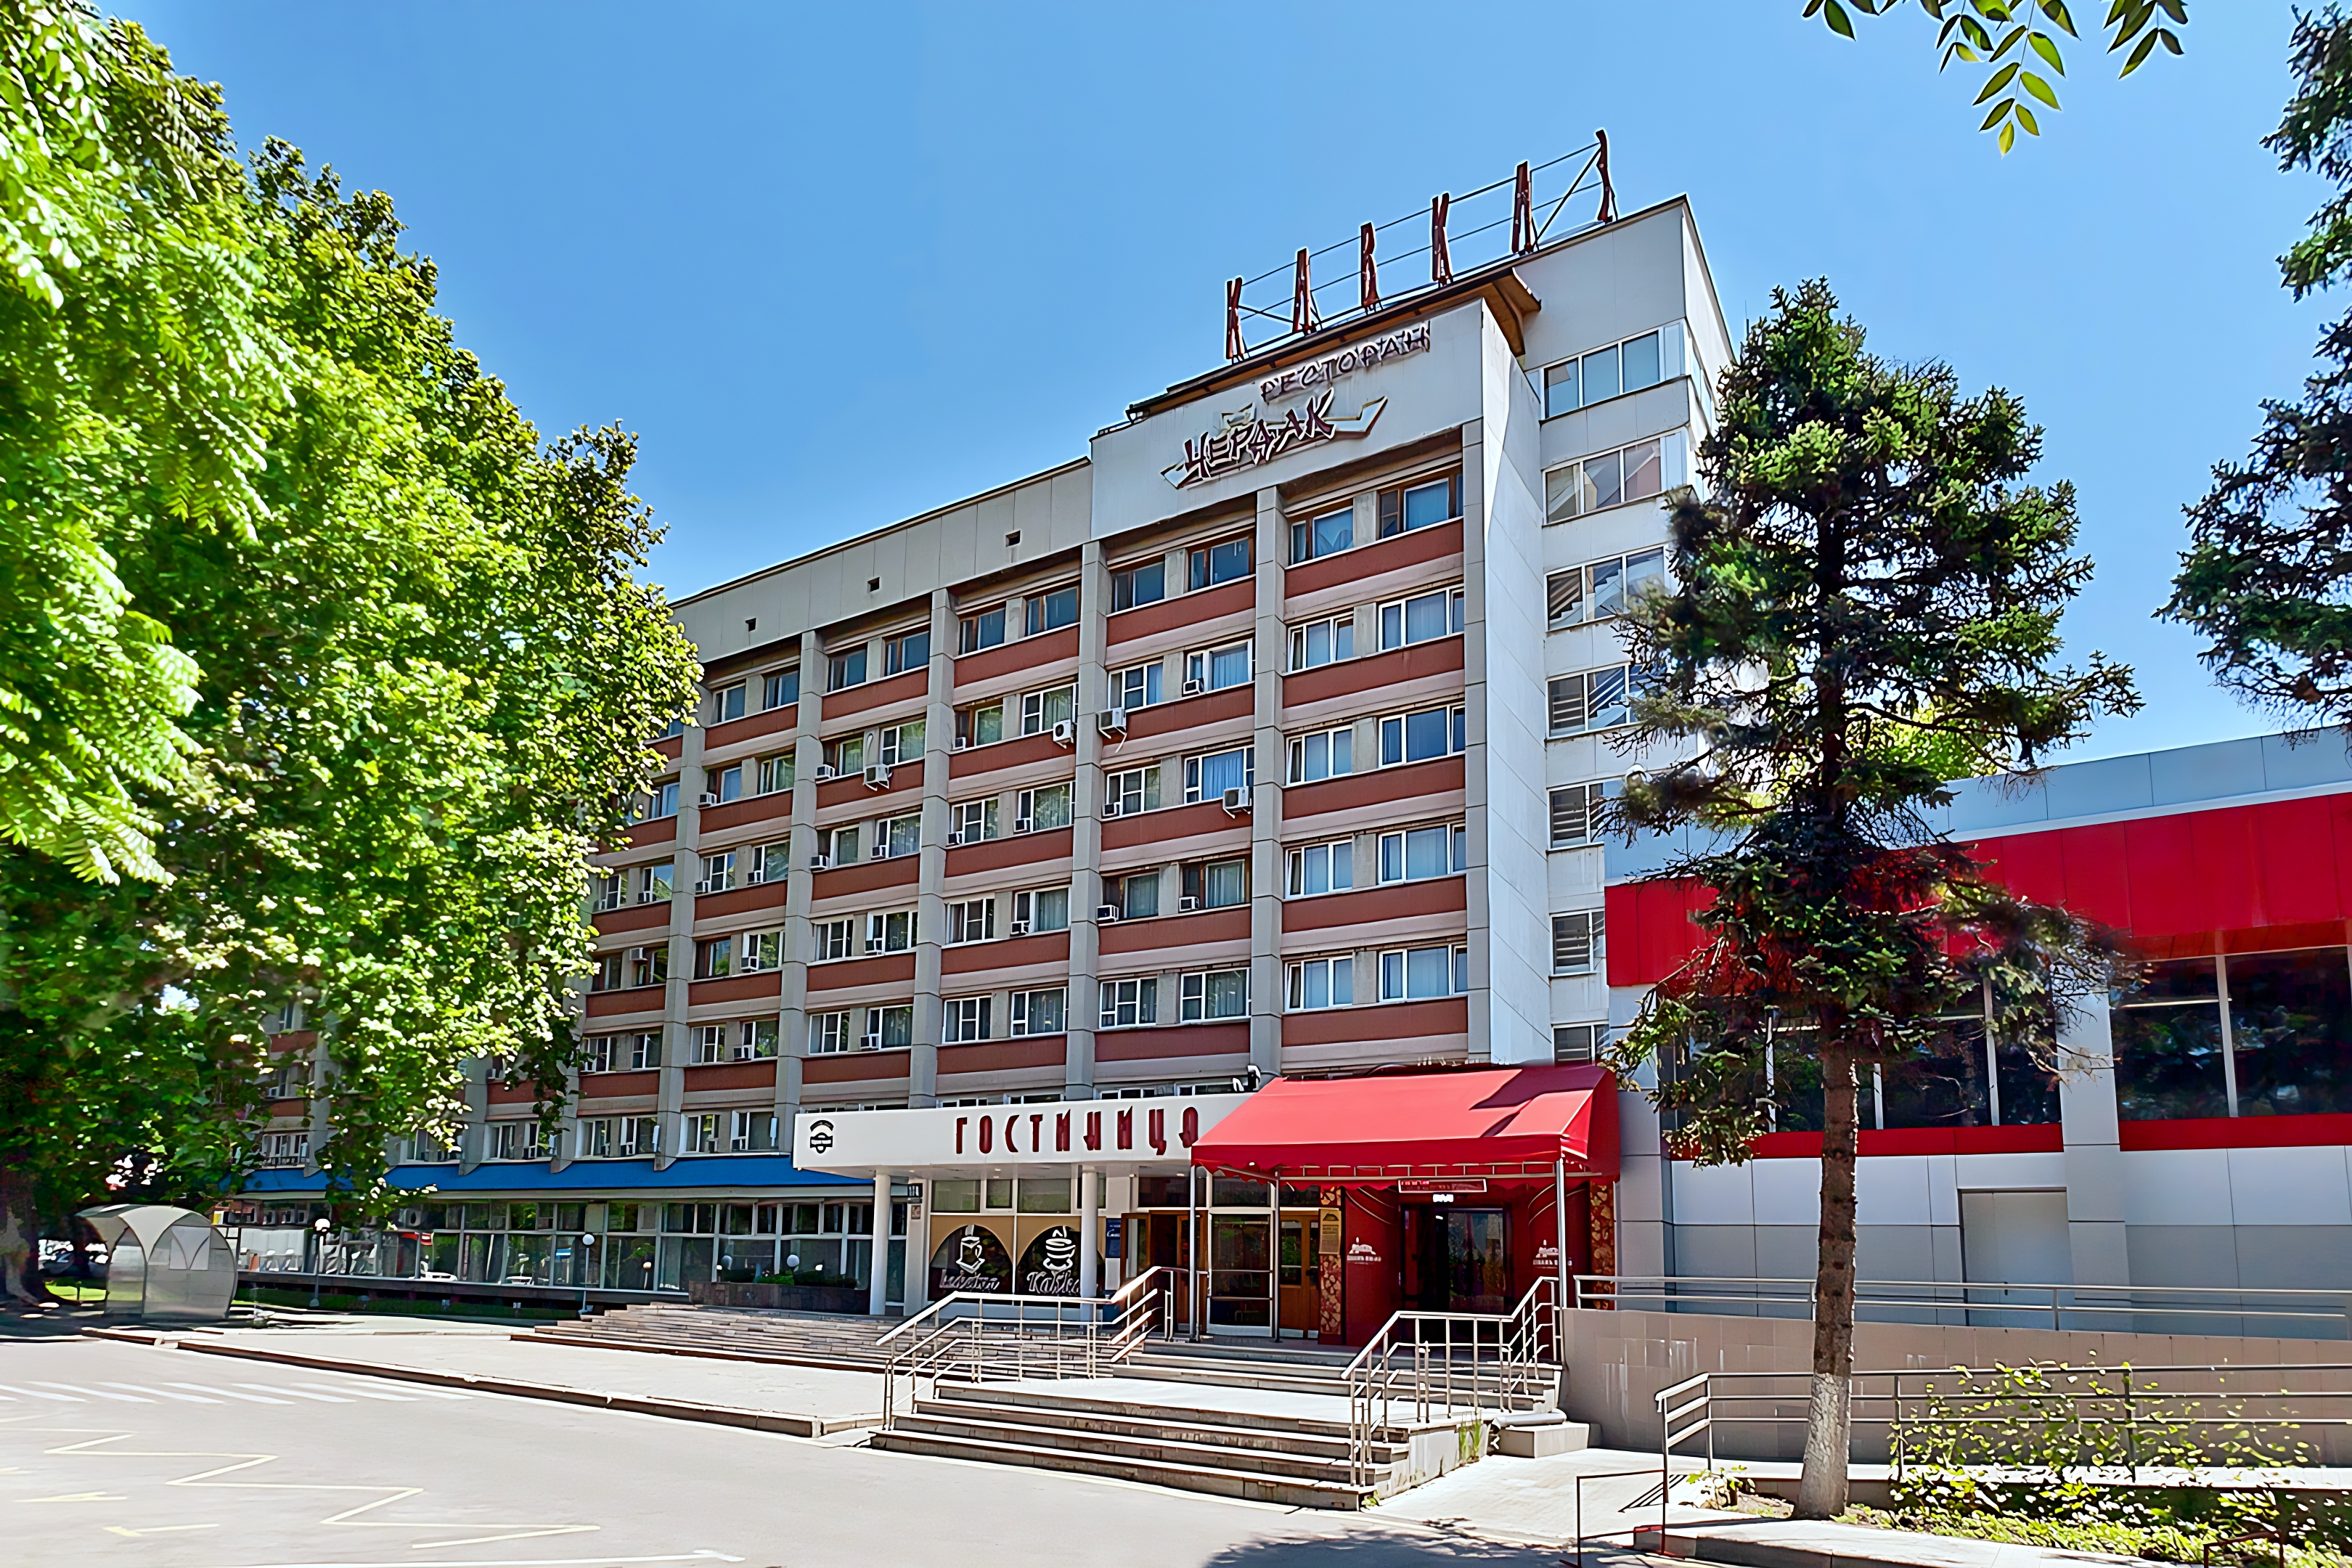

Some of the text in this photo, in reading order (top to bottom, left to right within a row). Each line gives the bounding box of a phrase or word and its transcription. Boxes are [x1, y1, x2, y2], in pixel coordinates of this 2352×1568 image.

[1260, 321, 1430, 404] РЕСТОРАН
[1183, 387, 1336, 478] ЧЕРДАК
[955, 1106, 1199, 1156] ГОСТИНИЦА
